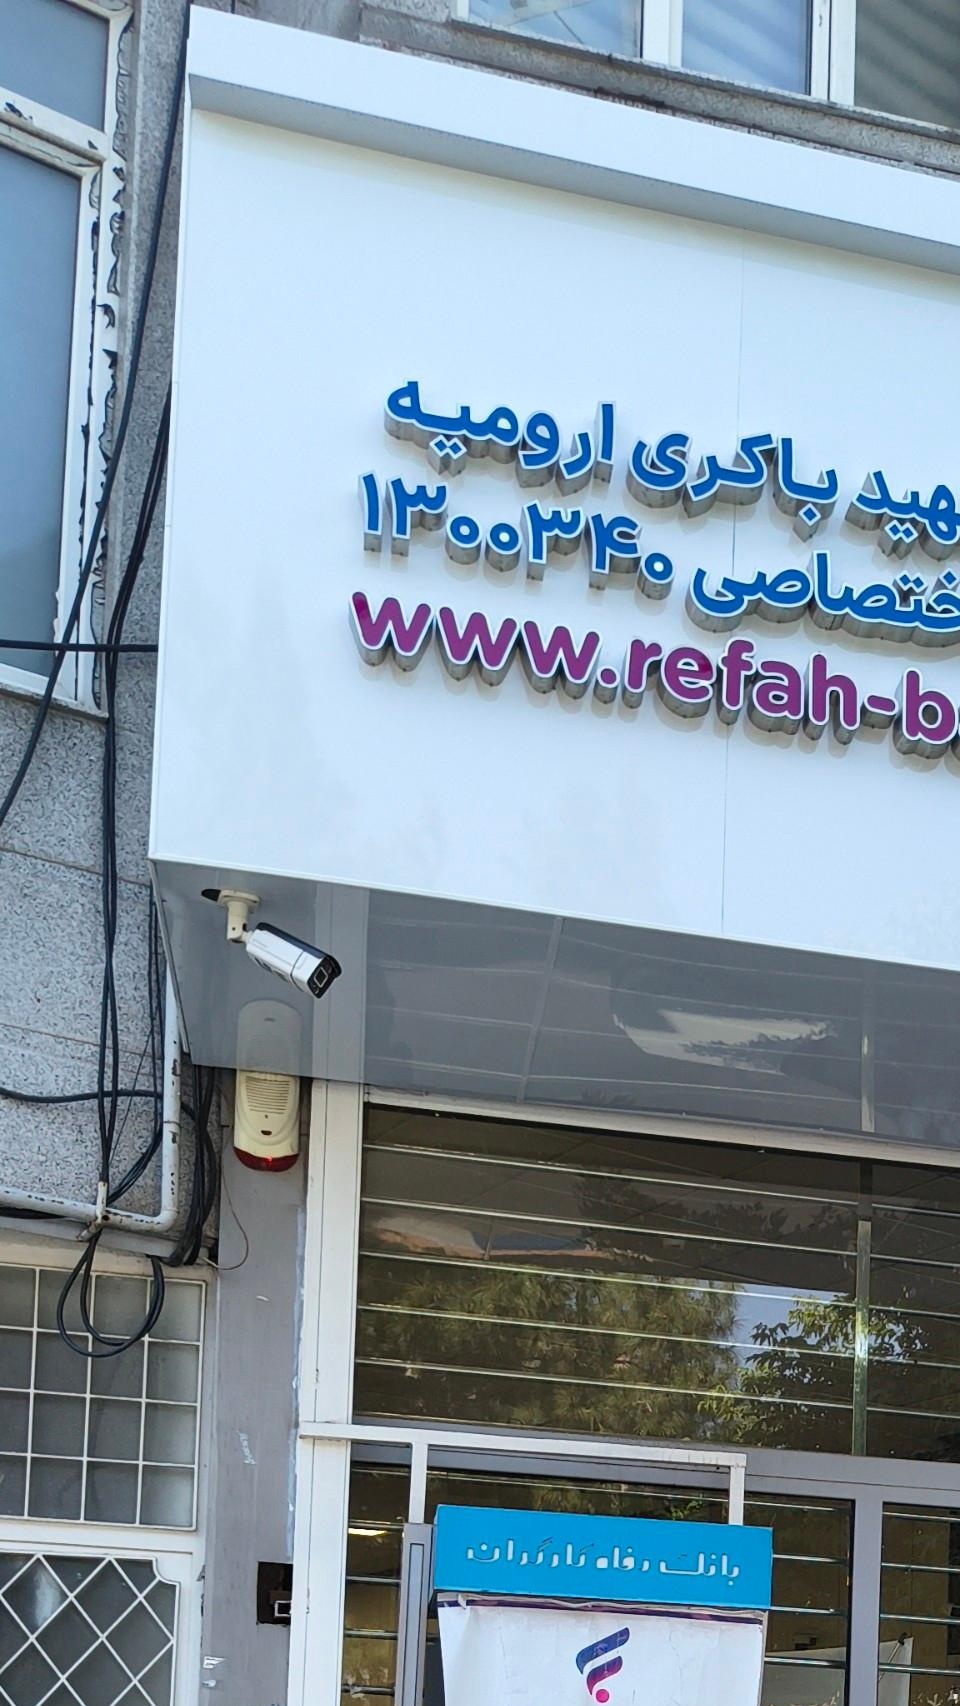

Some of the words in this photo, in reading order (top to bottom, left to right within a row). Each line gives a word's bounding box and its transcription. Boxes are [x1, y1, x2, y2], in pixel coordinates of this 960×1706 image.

[384, 379, 616, 481] ارومیه
[359, 472, 676, 582] ۱۳۰۰۳۴۰
[630, 432, 839, 527] باکری
[596, 1546, 650, 1572] رفاه
